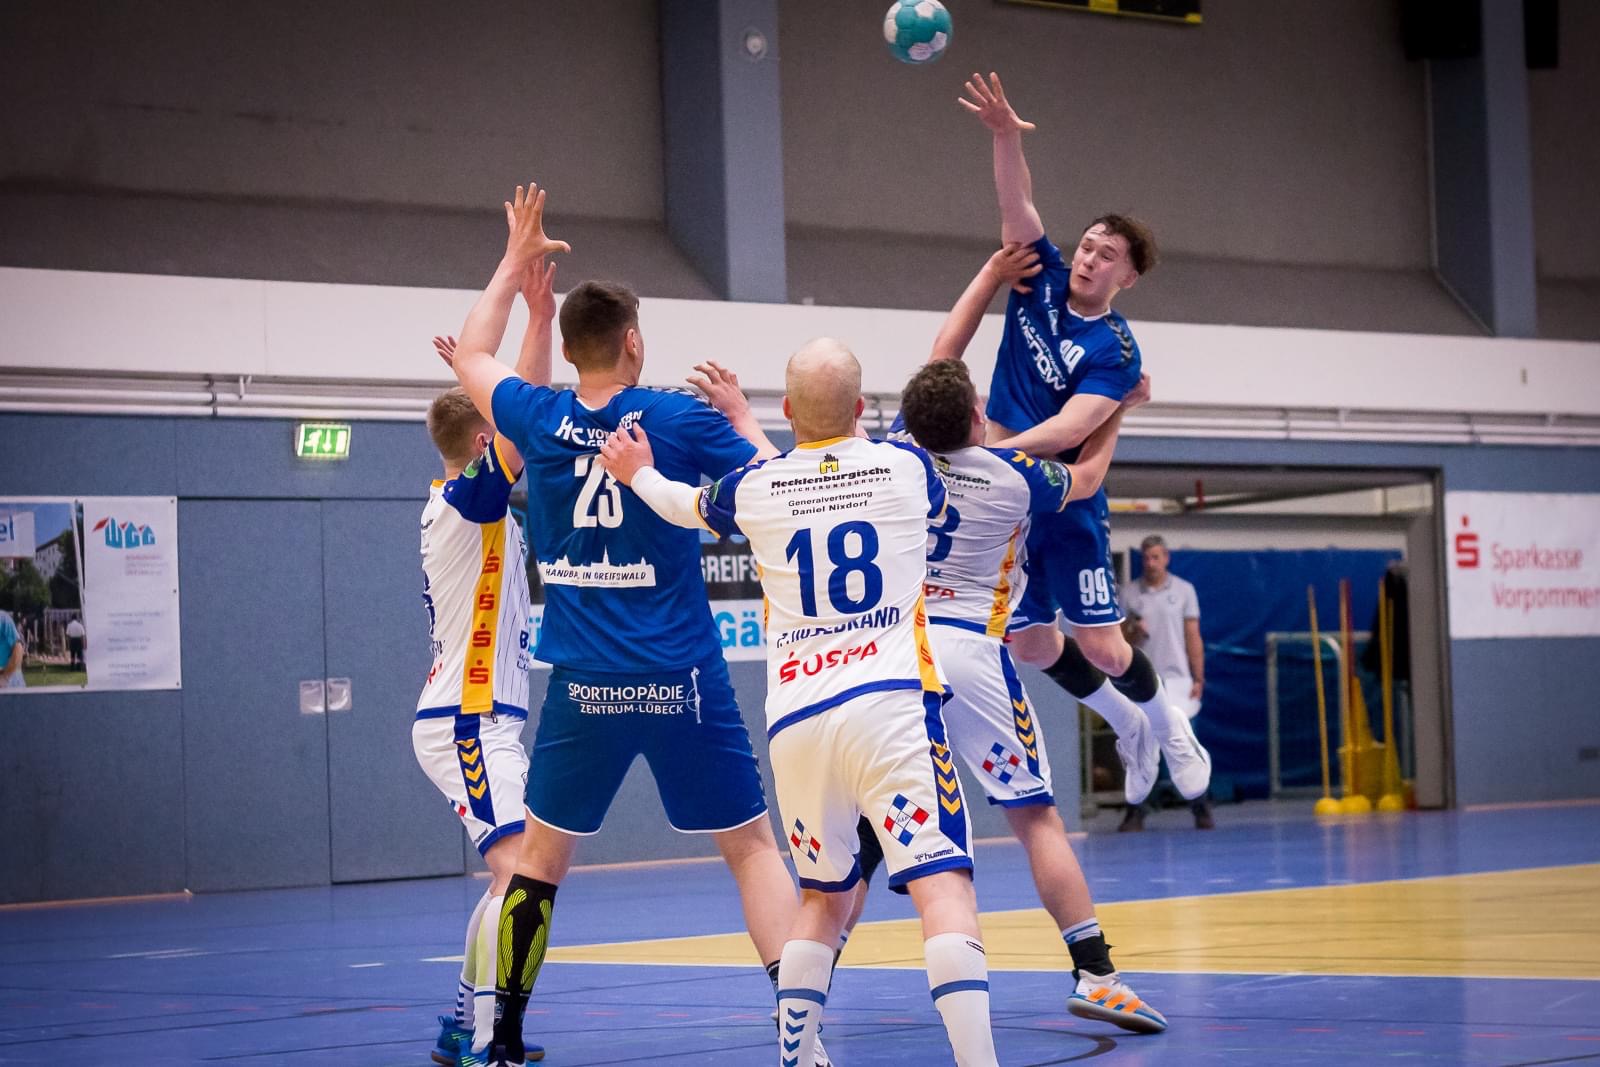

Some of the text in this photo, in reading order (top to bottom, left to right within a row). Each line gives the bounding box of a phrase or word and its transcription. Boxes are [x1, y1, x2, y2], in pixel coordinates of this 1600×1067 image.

[771, 467, 891, 489] Mecklenburgische
[788, 491, 873, 507] Generalvertretung
[792, 500, 868, 516] Daniel Nixdorf
[786, 520, 883, 618] 18
[1491, 543, 1583, 574] Sparkasse
[594, 571, 647, 580] GREIFSWALD
[1078, 568, 1110, 607] 99
[714, 610, 766, 649] Gä
[802, 640, 879, 677] OSPA
[568, 682, 684, 701] SPORTHOPÄDIE
[924, 846, 955, 861] hummel
